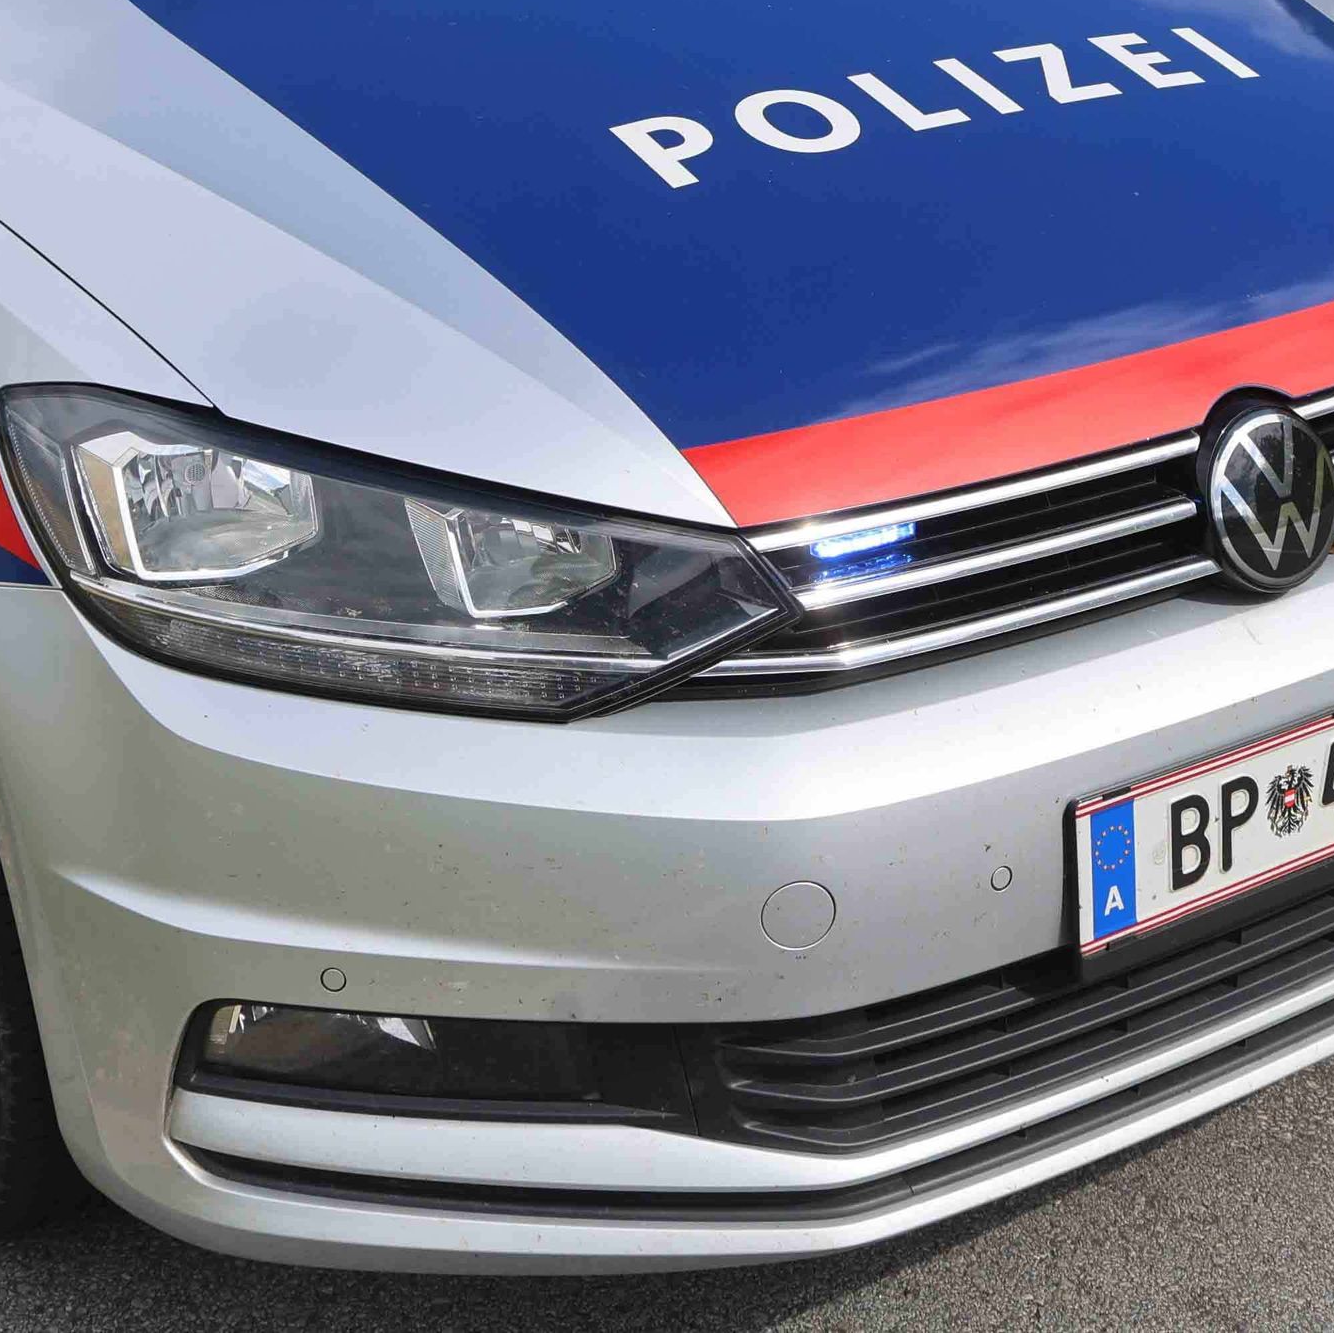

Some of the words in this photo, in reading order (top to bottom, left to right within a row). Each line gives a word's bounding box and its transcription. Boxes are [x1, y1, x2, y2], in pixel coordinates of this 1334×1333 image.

[609, 27, 1261, 189] POLIZEI
[1214, 412, 1334, 574] VW
[1104, 885, 1125, 917] A
[1170, 775, 1259, 891] BP
